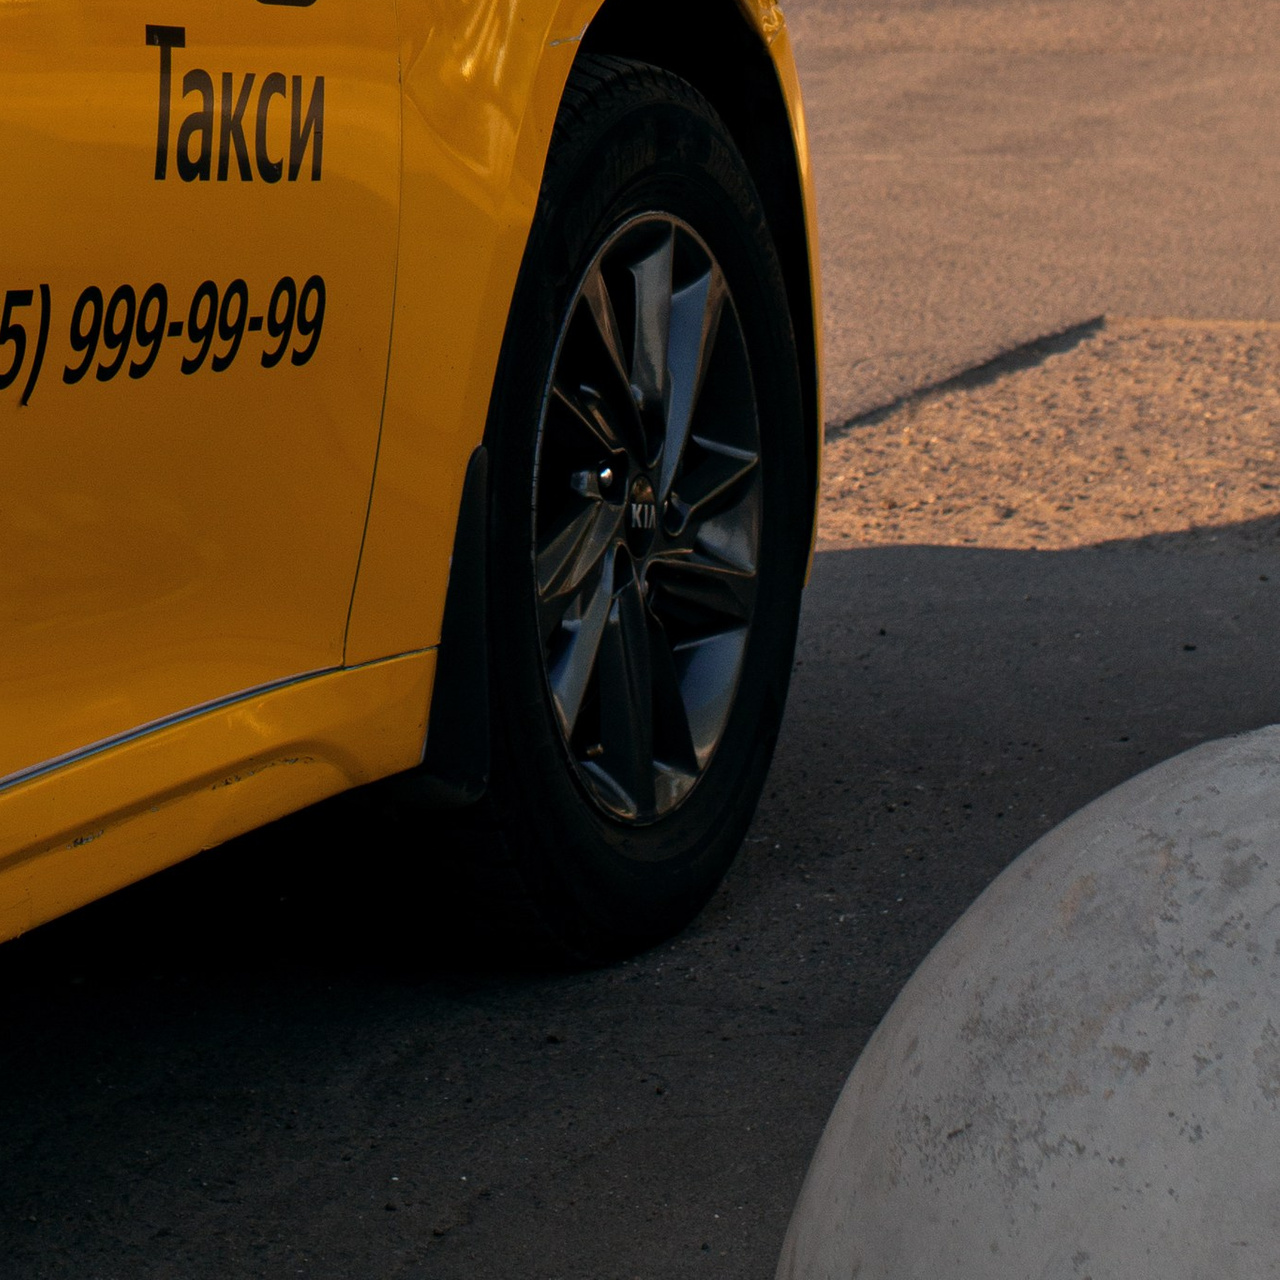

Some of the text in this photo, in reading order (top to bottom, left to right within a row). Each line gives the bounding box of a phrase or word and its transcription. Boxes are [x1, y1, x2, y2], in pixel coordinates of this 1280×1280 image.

[145, 24, 325, 184] Такси
[62, 273, 326, 386] 999-99-99
[631, 503, 657, 529] KIA
